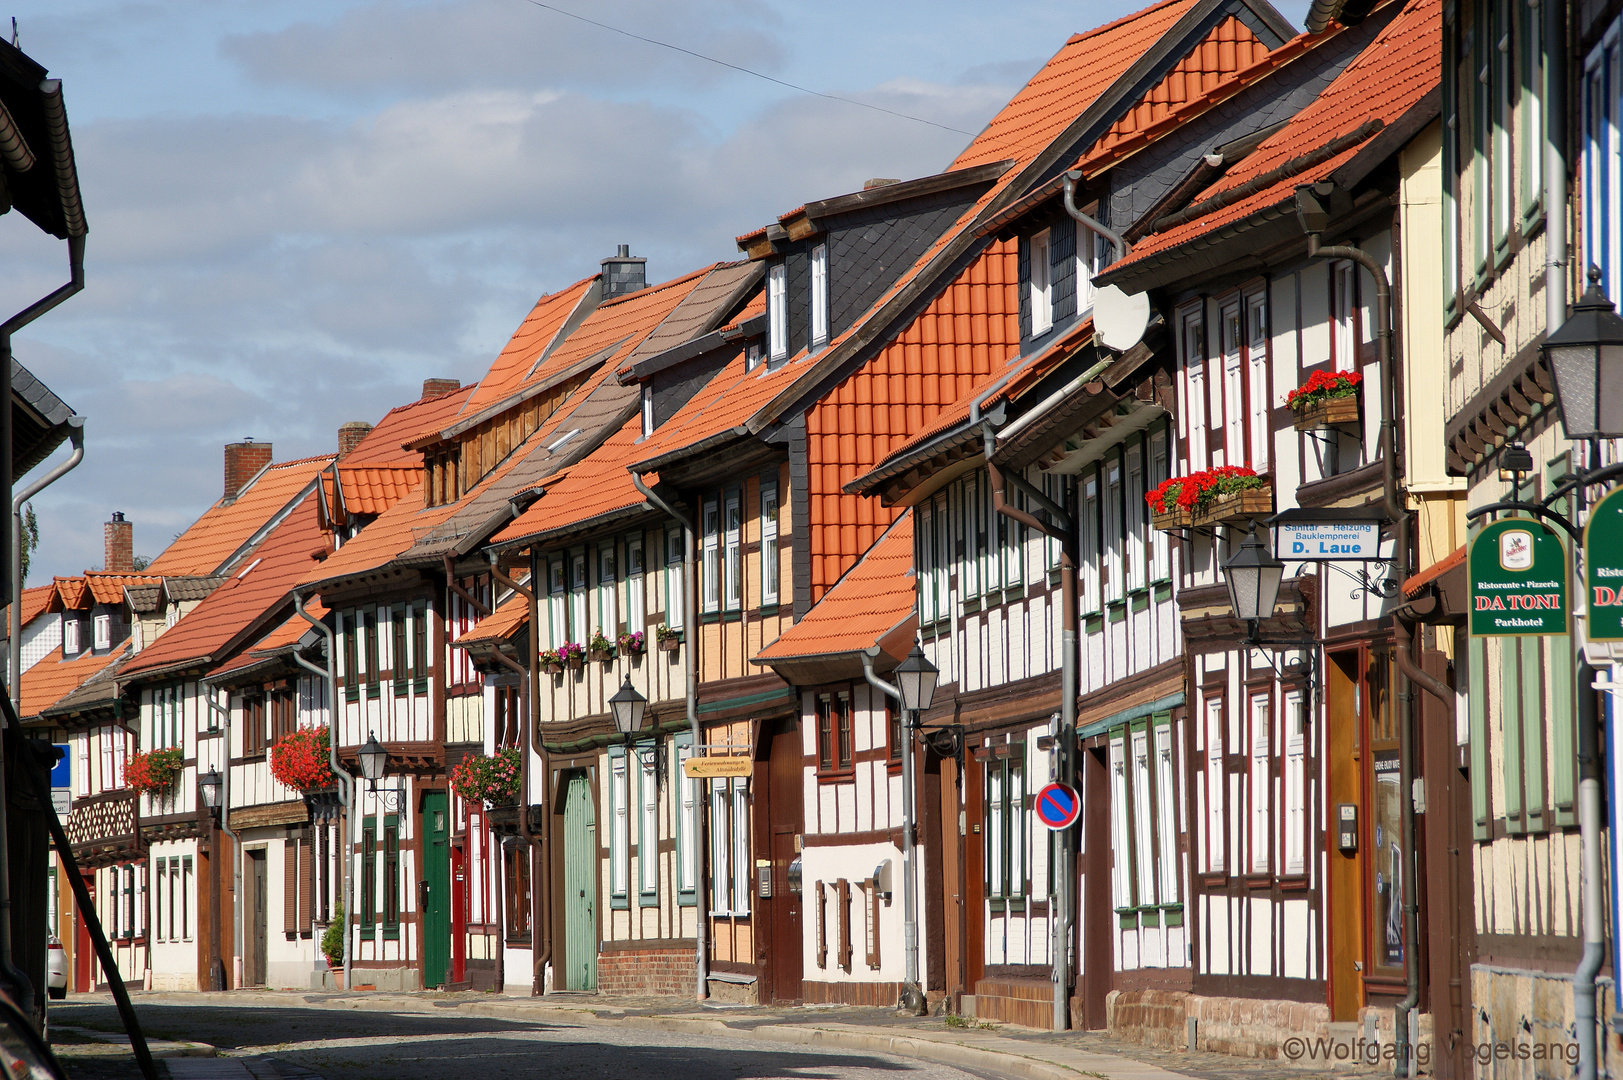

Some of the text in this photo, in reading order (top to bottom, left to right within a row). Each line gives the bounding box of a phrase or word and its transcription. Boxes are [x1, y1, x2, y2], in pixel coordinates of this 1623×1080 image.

[1284, 524, 1319, 532] Sanitär
[1333, 524, 1371, 532] Heizung
[1295, 532, 1360, 541] Bauklempnerei
[1292, 541, 1362, 554] D. Laue
[1478, 580, 1559, 590] Ristorante Pizzeria
[1475, 594, 1561, 611] DA TONI
[1494, 617, 1544, 627] Parkhotel
